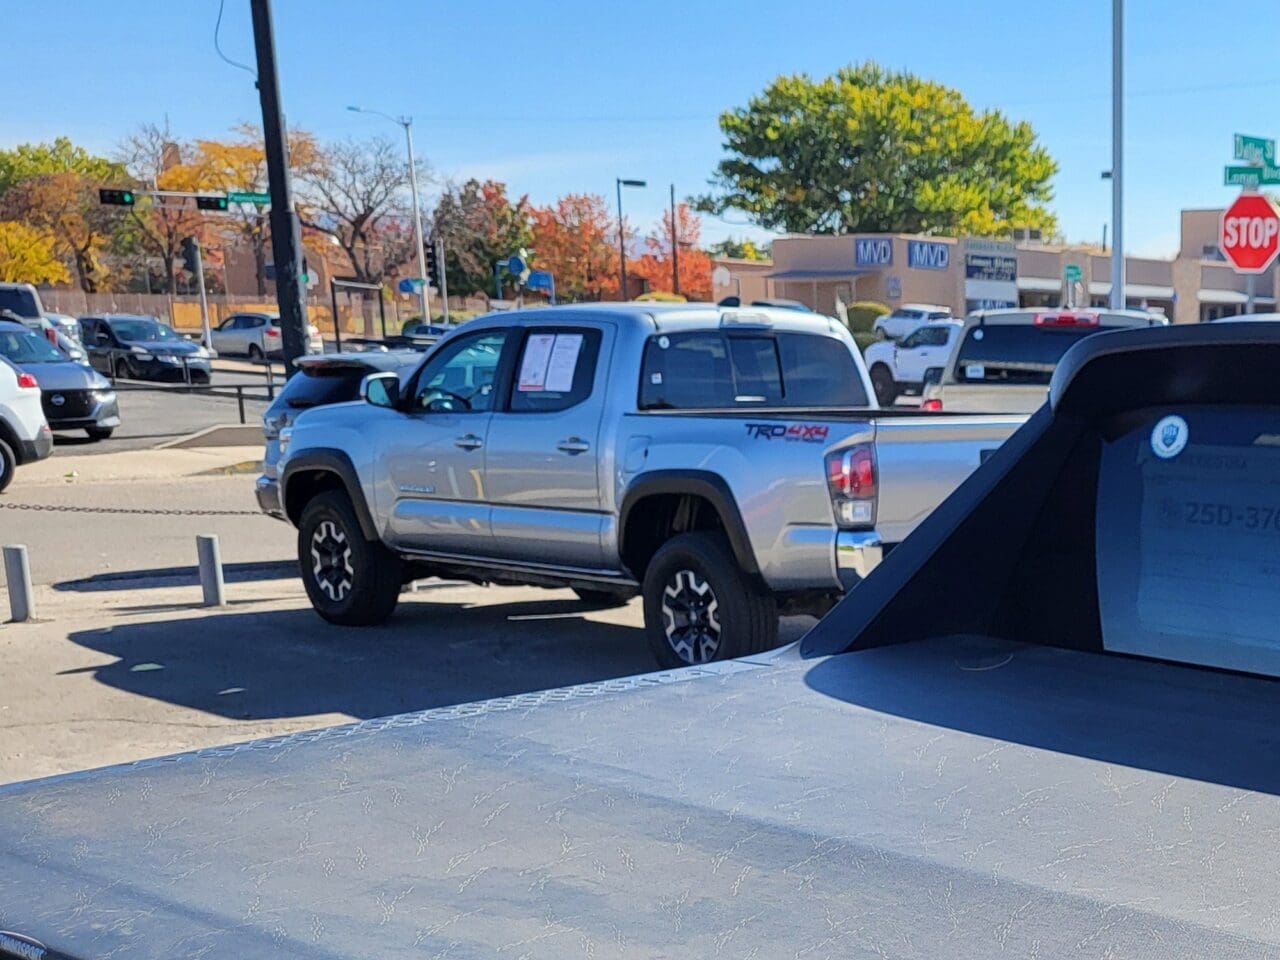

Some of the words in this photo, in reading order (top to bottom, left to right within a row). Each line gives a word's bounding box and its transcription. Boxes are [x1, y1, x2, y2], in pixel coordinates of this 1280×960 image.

[1223, 215, 1278, 249] STOP
[857, 239, 892, 264] MVD
[914, 242, 949, 268] MVD
